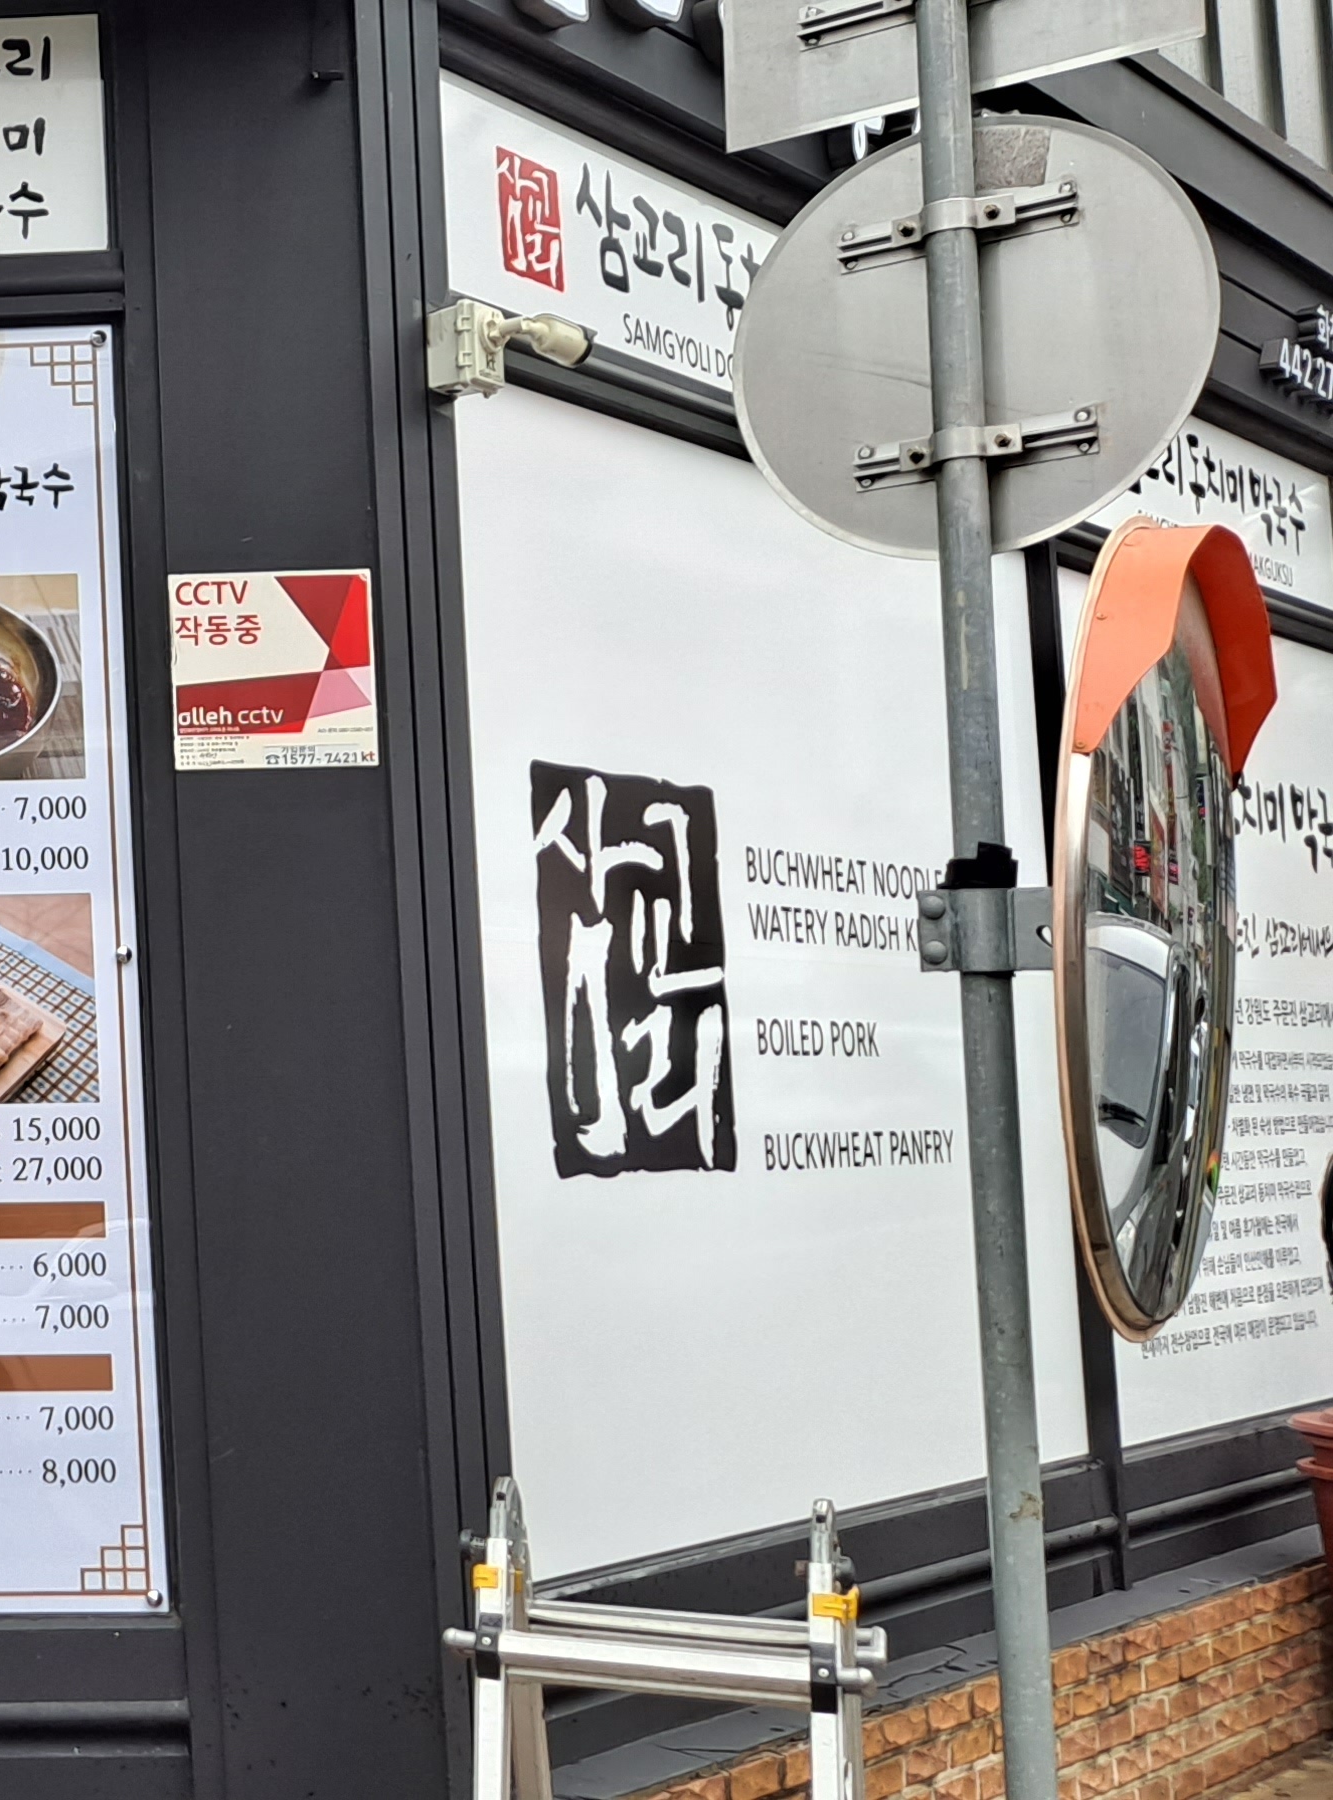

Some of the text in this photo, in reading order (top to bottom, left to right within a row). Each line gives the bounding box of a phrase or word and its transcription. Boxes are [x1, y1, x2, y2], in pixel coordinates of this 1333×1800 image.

[577, 161, 705, 303] 삼교리
[1317, 304, 1333, 349] 화
[623, 312, 710, 374] SAMGYOLI
[1280, 337, 1333, 400] 442 27
[1186, 433, 1245, 514] 동치미
[1248, 468, 1306, 555] 막국수
[1249, 552, 1293, 587] AKGUKSU
[175, 580, 248, 605] CCTV
[175, 614, 261, 646] 작동중
[177, 706, 284, 726] olleh cctv
[13, 796, 87, 823] 7,000
[1, 846, 89, 874] 10,000
[745, 846, 867, 894] BUCHWHEAT
[748, 902, 829, 945] WATERY
[835, 910, 900, 951] RADISH
[756, 1018, 881, 1058] BOILED PORK
[12, 1117, 101, 1145] 15,000
[764, 1130, 954, 1172] BUCKWHEAT PANFRY
[12, 1157, 102, 1185] 27,000
[33, 1252, 107, 1281] 6,000
[35, 1304, 109, 1333] 7,000
[39, 1406, 114, 1434] 7,000
[42, 1459, 116, 1487] 8,000
